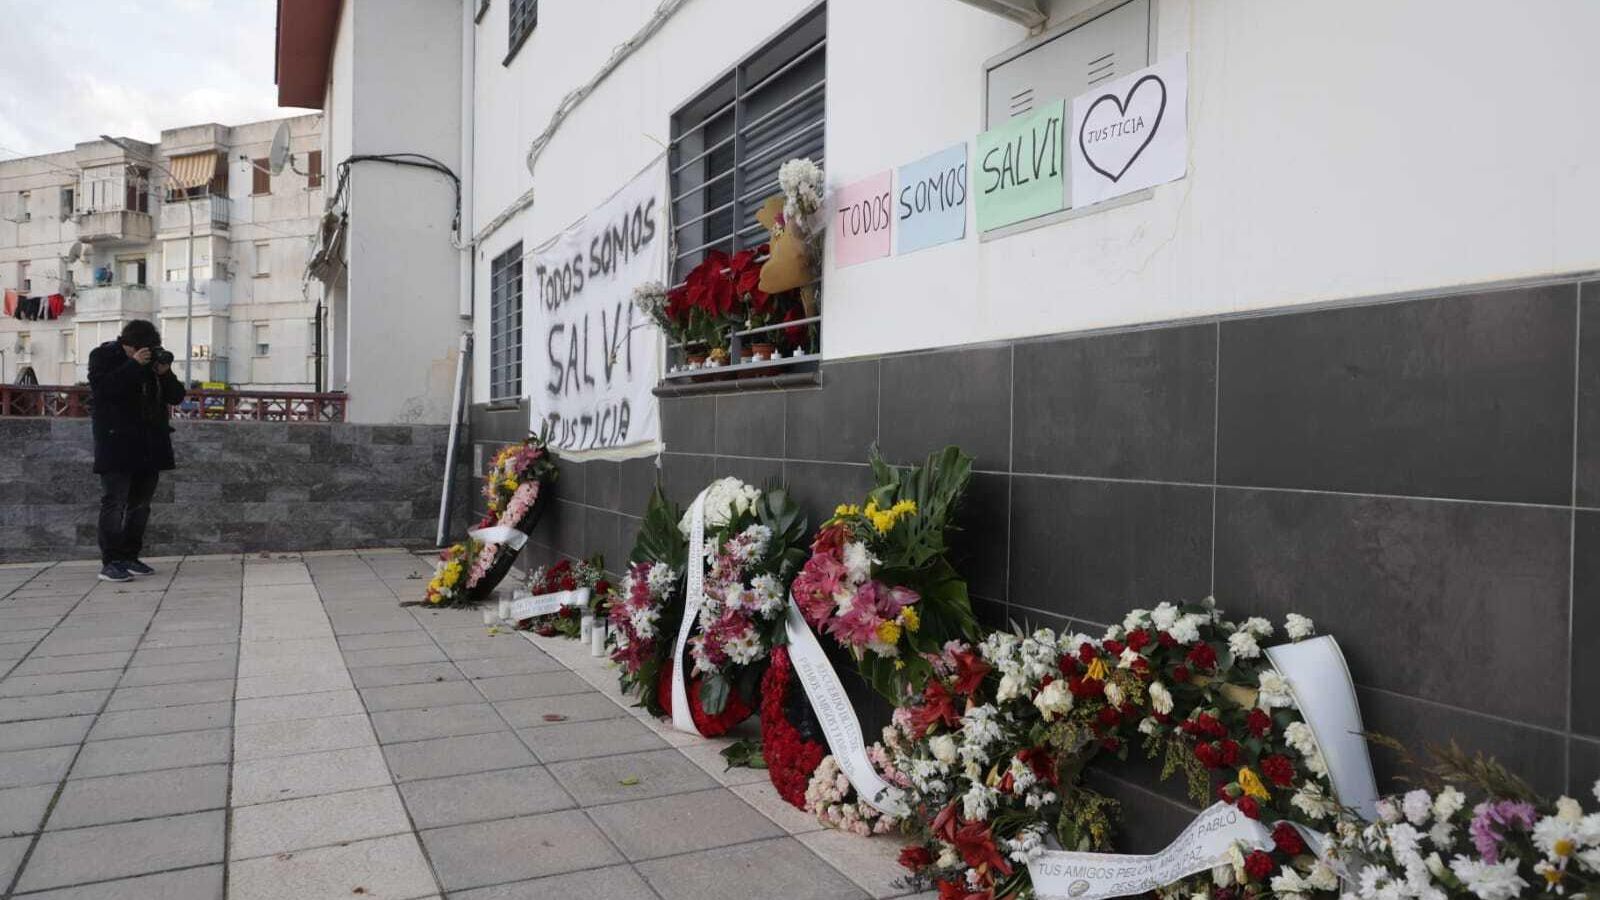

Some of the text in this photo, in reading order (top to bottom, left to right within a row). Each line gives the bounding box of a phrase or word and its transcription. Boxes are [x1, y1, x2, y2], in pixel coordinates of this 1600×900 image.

[1087, 115, 1145, 144] JUSTICIA
[838, 117, 1061, 238] TODOS SOMOS SALVI
[536, 197, 656, 312] TODOS SOMOS
[547, 302, 634, 396] SALVI
[1039, 863, 1061, 876] TUS
[1063, 865, 1115, 880] AMIGOS
[1198, 810, 1238, 839] PABLO
